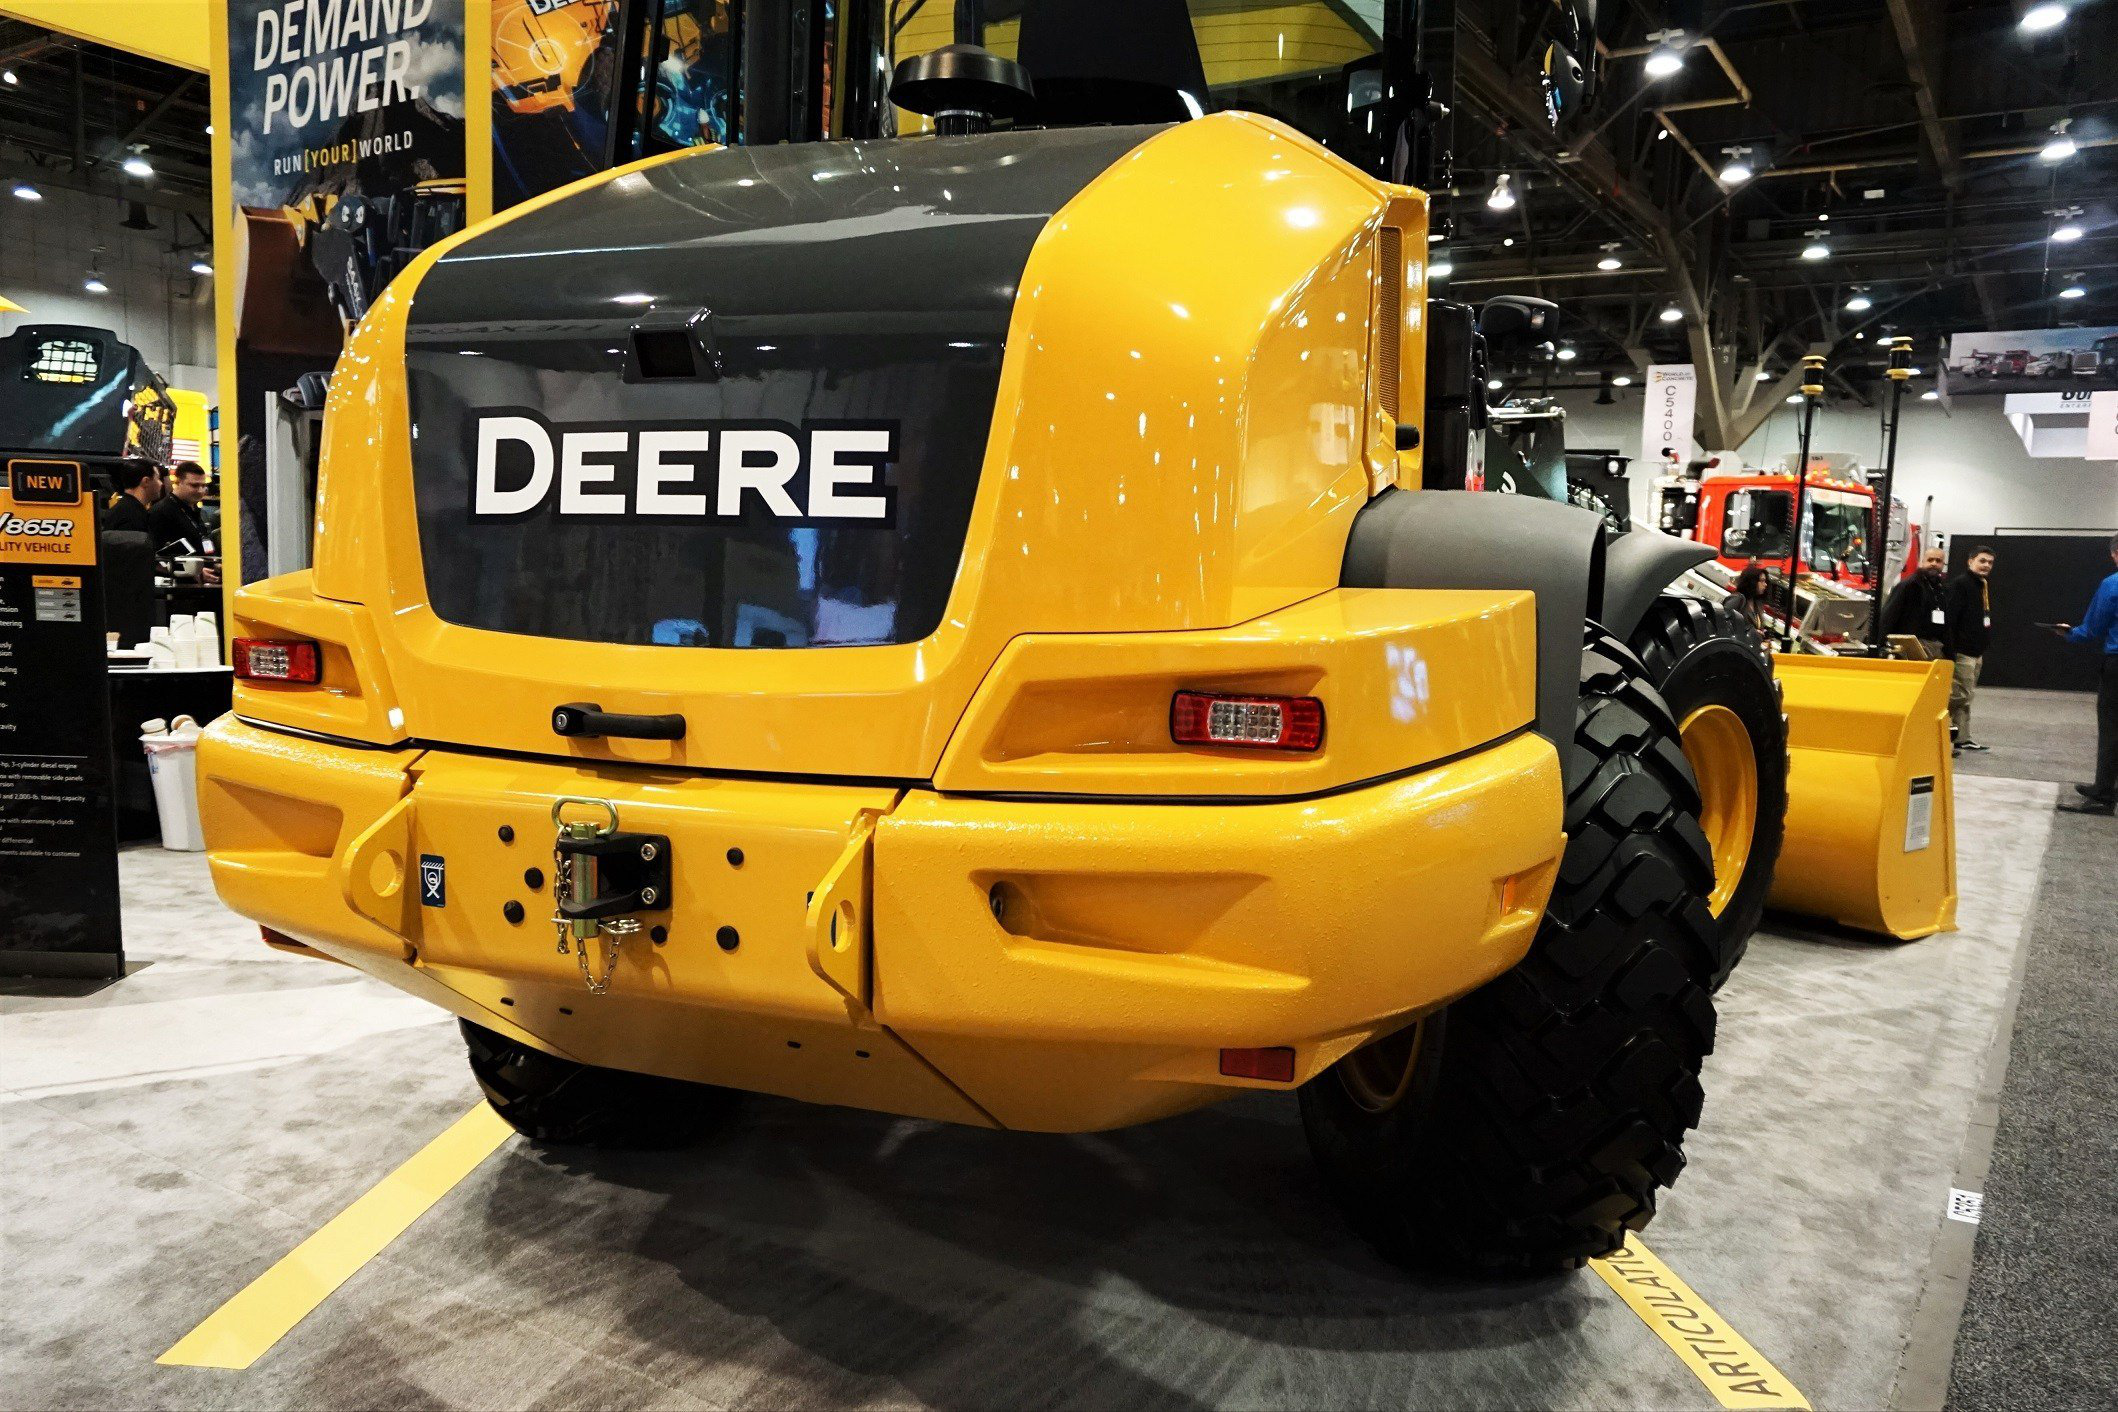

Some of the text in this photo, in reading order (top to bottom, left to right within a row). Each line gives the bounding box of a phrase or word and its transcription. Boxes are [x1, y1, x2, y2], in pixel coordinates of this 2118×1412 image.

[254, 0, 433, 71] DEMAND
[263, 40, 421, 134] POWER.
[475, 415, 890, 519] DEERE
[25, 542, 72, 554] VEHICLE
